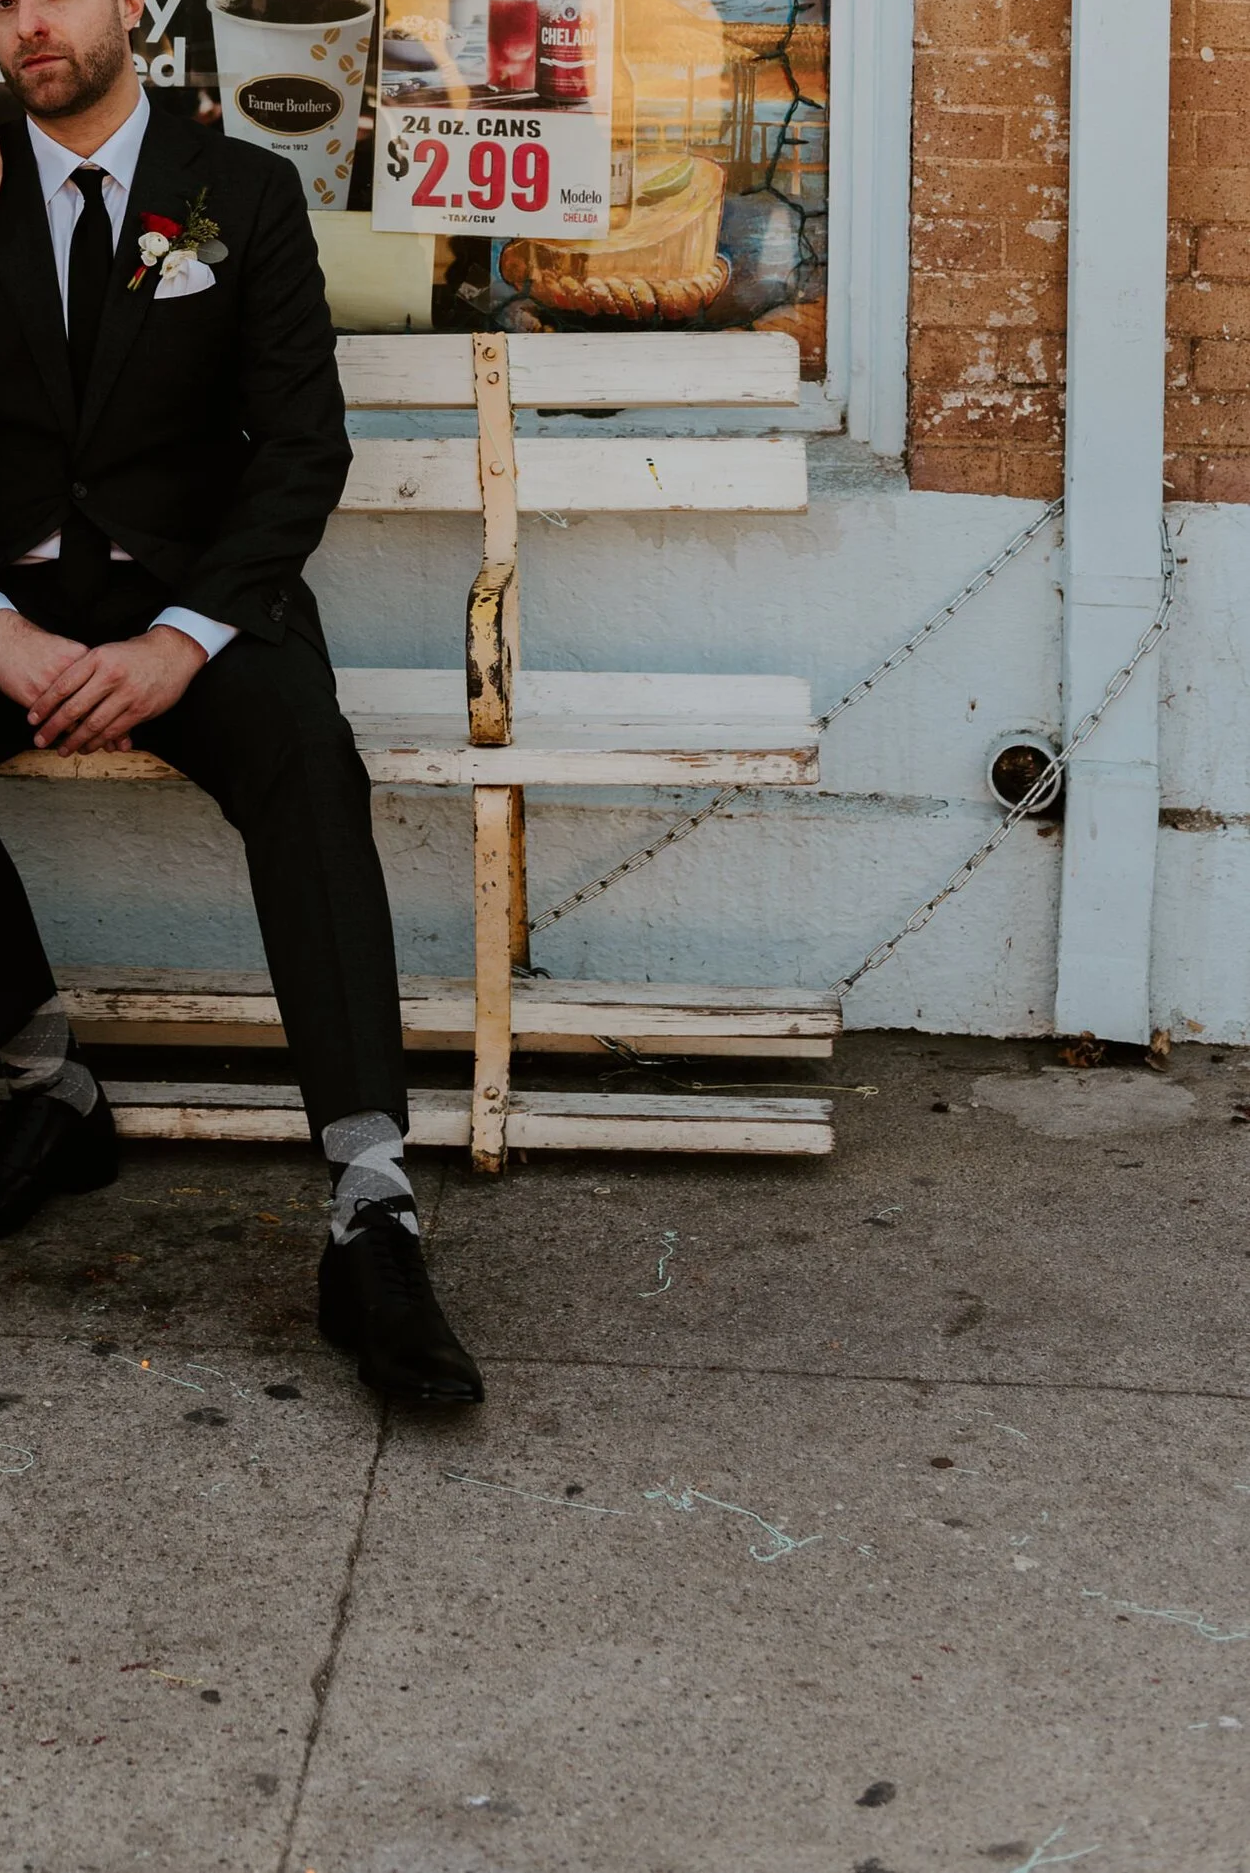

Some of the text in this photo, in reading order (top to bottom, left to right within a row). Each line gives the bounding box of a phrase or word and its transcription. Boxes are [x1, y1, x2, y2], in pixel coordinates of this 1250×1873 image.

[247, 94, 333, 114] Farmer Brothers
[401, 115, 432, 134] 24
[477, 118, 542, 138] CANS
[271, 142, 309, 152] Since 1912
[387, 135, 550, 213] $2.99
[560, 188, 603, 205] Modelo
[563, 212, 599, 224] CHELADA
